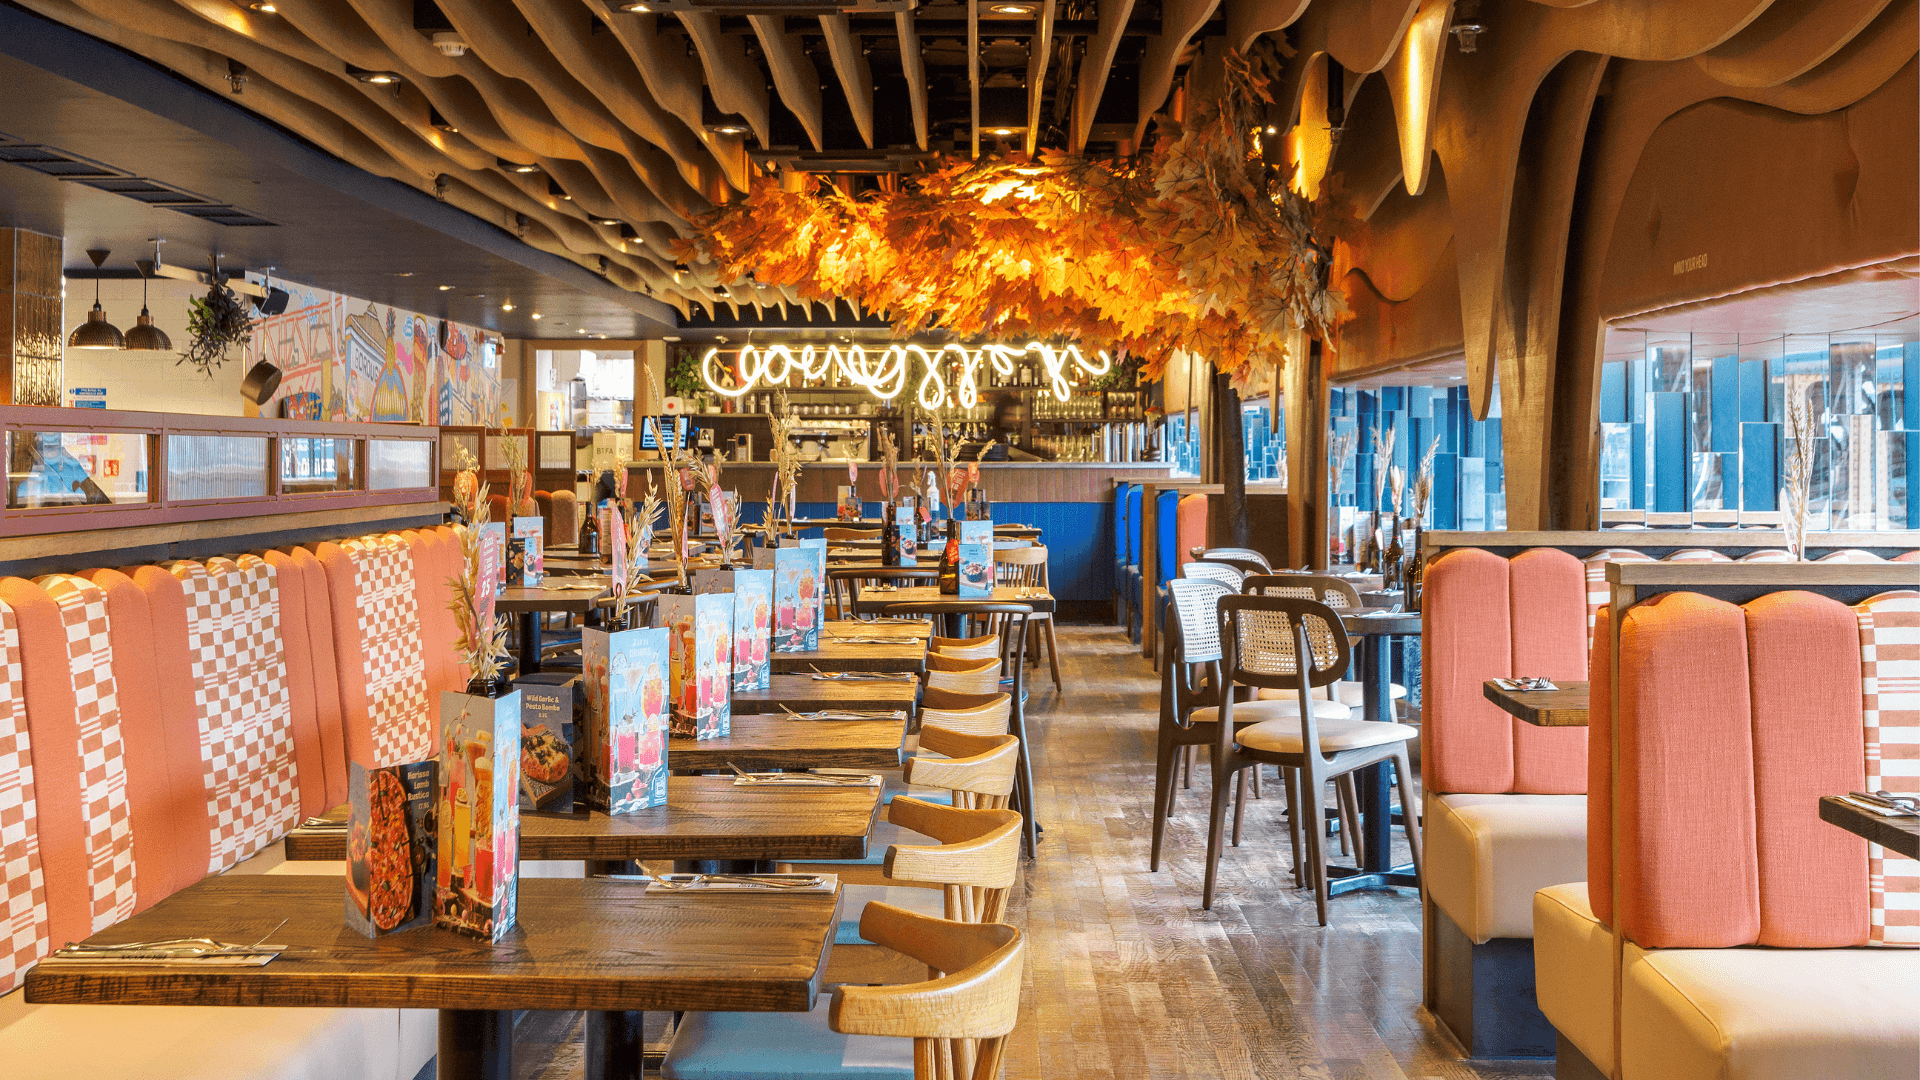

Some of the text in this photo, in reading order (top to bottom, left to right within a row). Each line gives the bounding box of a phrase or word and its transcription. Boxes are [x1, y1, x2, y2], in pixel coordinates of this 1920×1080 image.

[1673, 253, 1708, 275] MIND YOUR HEAD
[526, 694, 538, 702] Wild
[539, 695, 554, 703] Garlic
[525, 702, 541, 710] Pesto
[407, 770, 430, 780] Harissa
[413, 779, 430, 789] Lamb
[407, 790, 430, 801] Rustica
